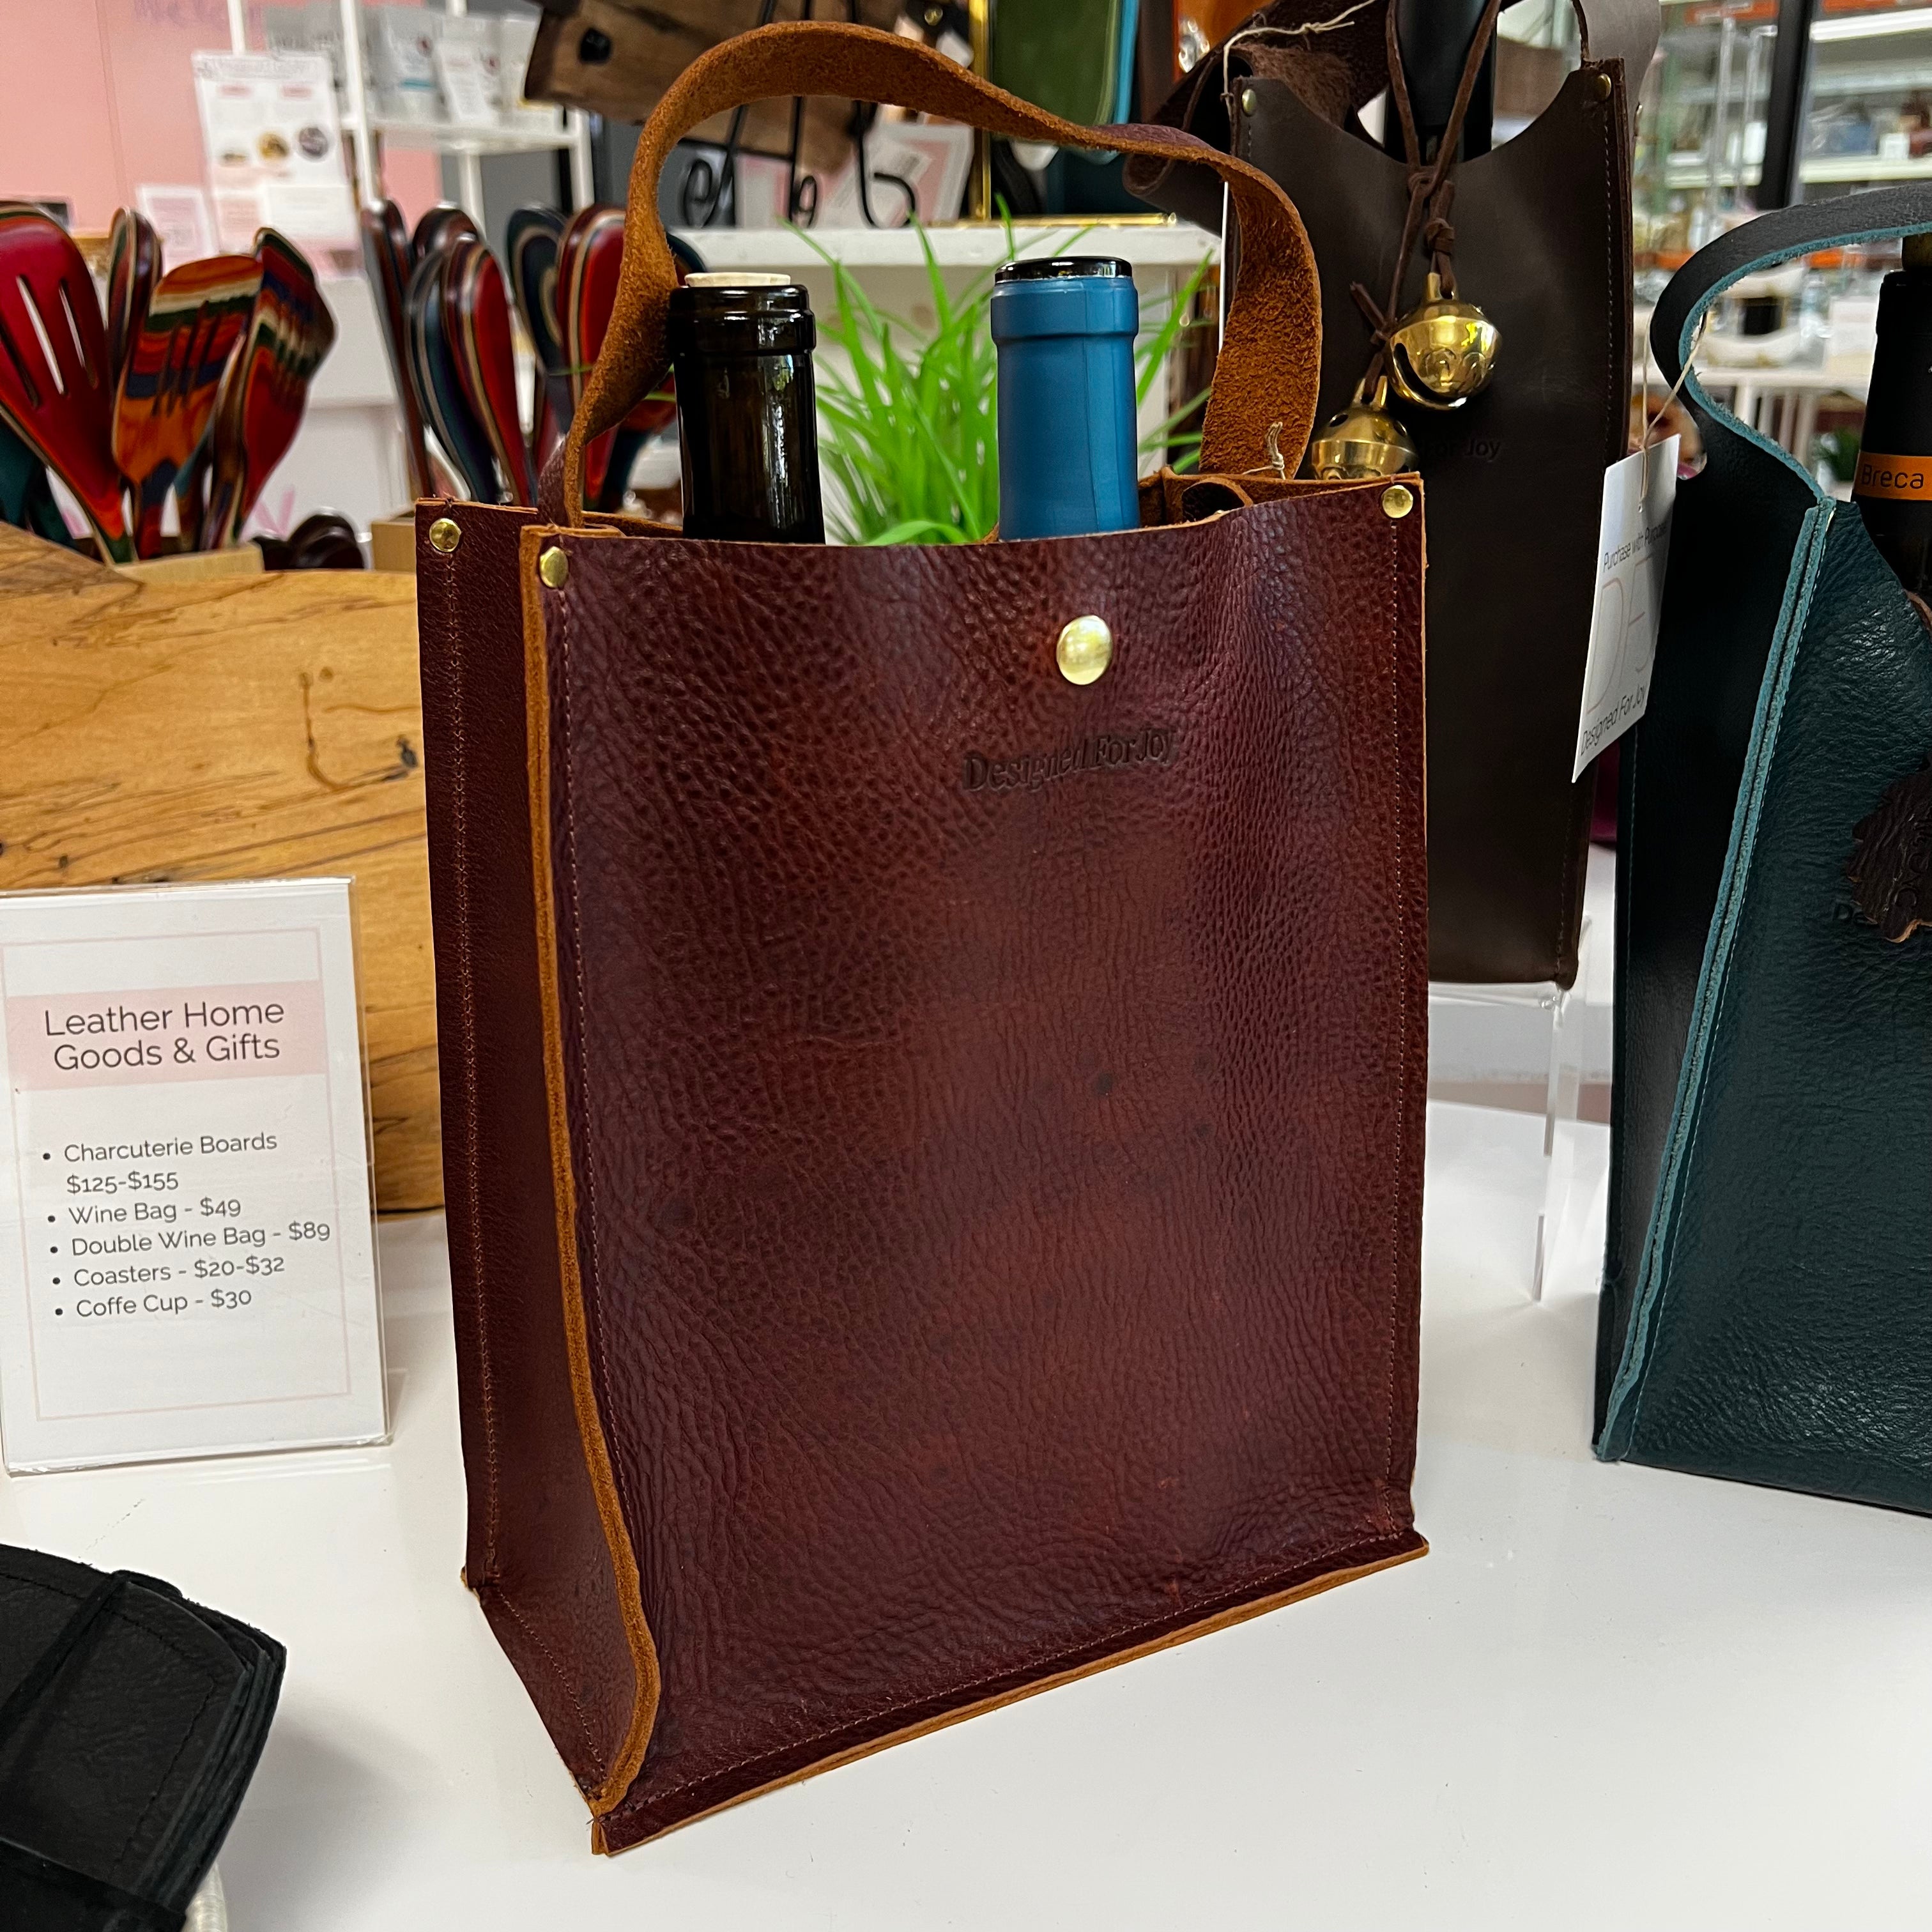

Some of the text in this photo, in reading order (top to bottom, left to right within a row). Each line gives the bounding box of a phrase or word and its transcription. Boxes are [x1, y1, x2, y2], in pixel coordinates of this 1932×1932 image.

[1862, 464, 1924, 489] Breca
[1603, 542, 1631, 572] Purchase
[1581, 684, 1647, 756] Designed For Joy
[963, 740, 1087, 792] Designed
[1094, 737, 1135, 765] For
[45, 1002, 284, 1036] Leather Home
[54, 1033, 280, 1070] Goods & Gifts
[65, 1132, 277, 1163] Charcuterie Boards
[66, 1170, 179, 1194] $125-$155
[69, 1205, 127, 1224] Wine
[135, 1202, 177, 1223] Bag
[200, 1197, 241, 1218] $49
[72, 1232, 152, 1256] Double
[158, 1229, 217, 1249] Wine
[224, 1226, 266, 1246] Bag
[289, 1221, 330, 1241] $89
[74, 1264, 171, 1287] Coasters
[194, 1254, 285, 1279] $20-$32
[77, 1296, 137, 1317] Coffe
[144, 1293, 188, 1315] Cup
[211, 1288, 252, 1309] $30
